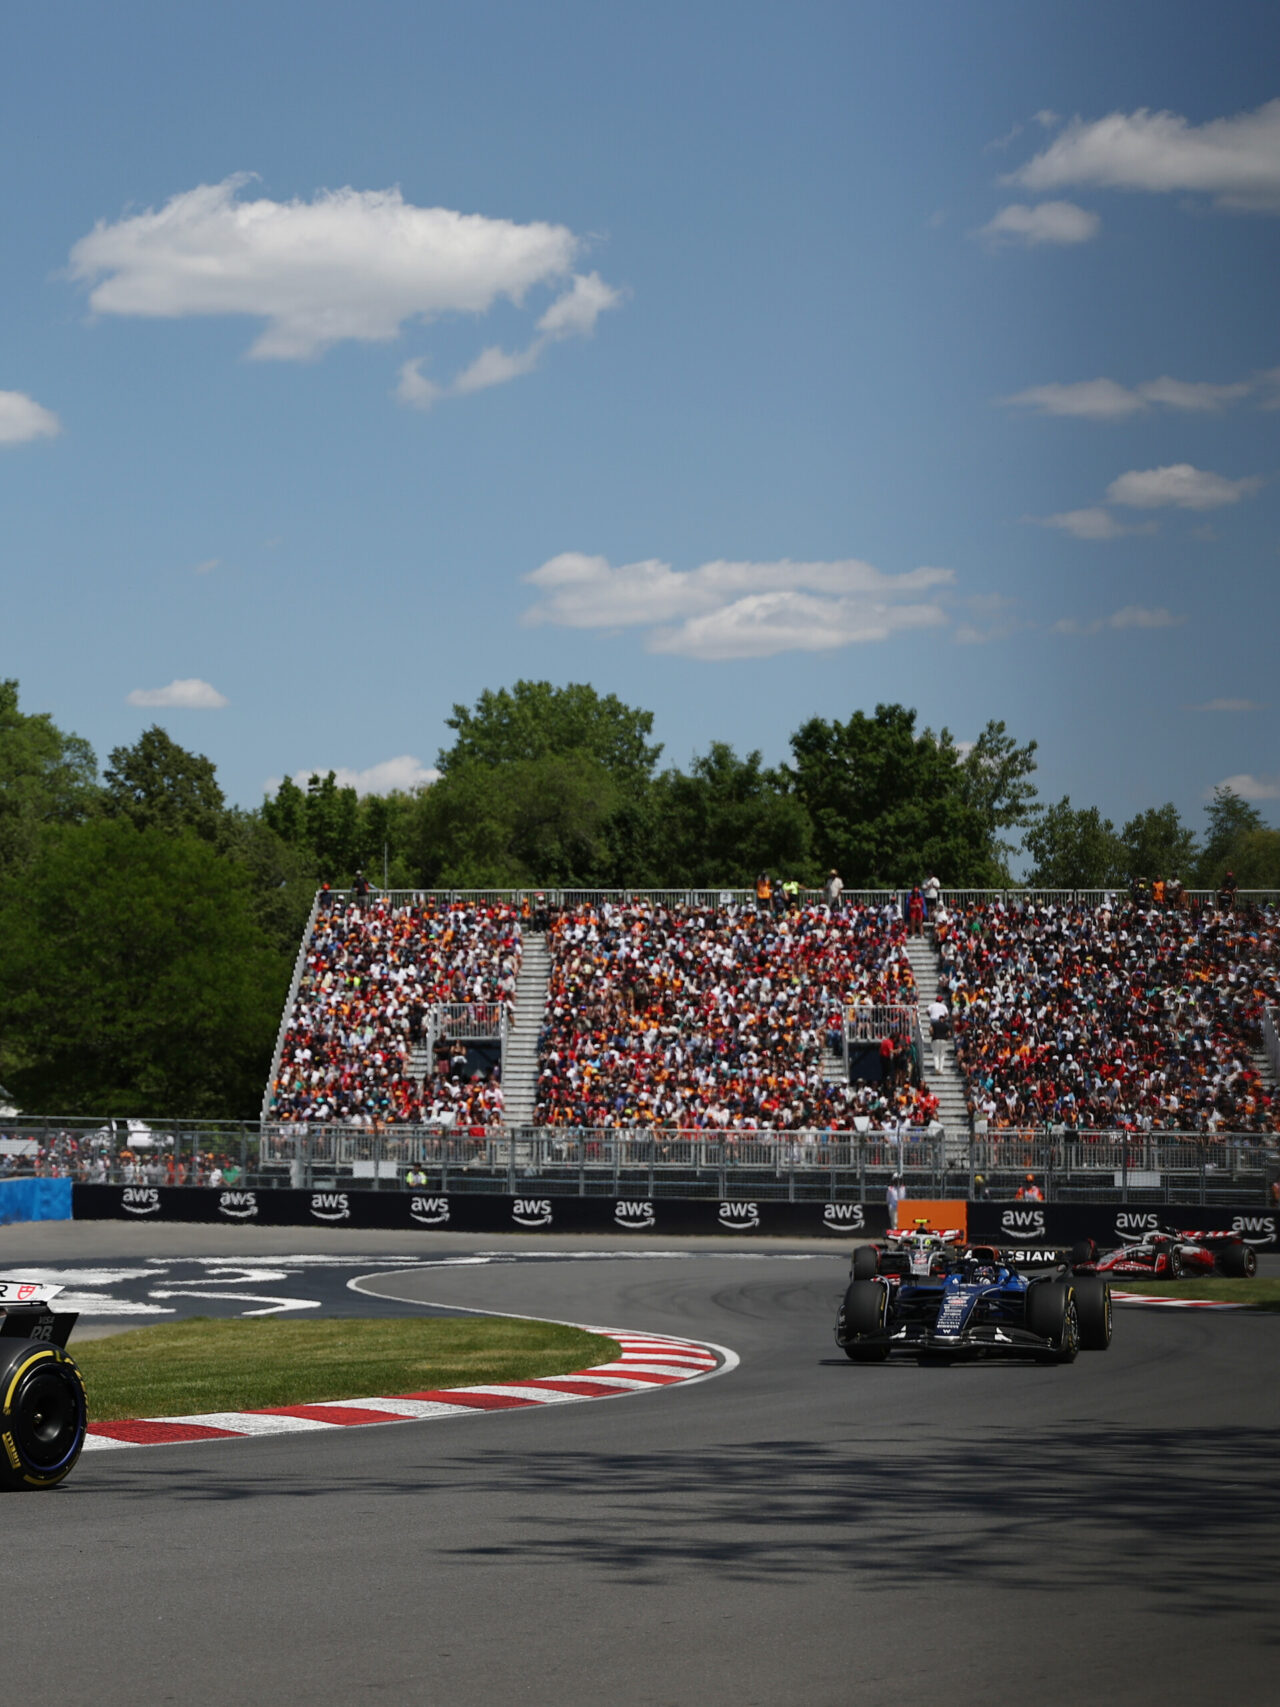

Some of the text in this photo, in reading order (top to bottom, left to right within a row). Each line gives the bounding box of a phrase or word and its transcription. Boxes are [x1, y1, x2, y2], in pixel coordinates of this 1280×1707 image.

[123, 1187, 158, 1203] aws
[220, 1191, 255, 1206] aws
[312, 1194, 348, 1208] aws
[412, 1197, 448, 1213] aws
[514, 1199, 552, 1214] aws
[616, 1201, 653, 1216] aws
[720, 1202, 758, 1217] aws
[825, 1204, 863, 1219] aws
[1003, 1211, 1044, 1226] aws
[1117, 1213, 1158, 1228] aws
[1233, 1217, 1275, 1232] aws
